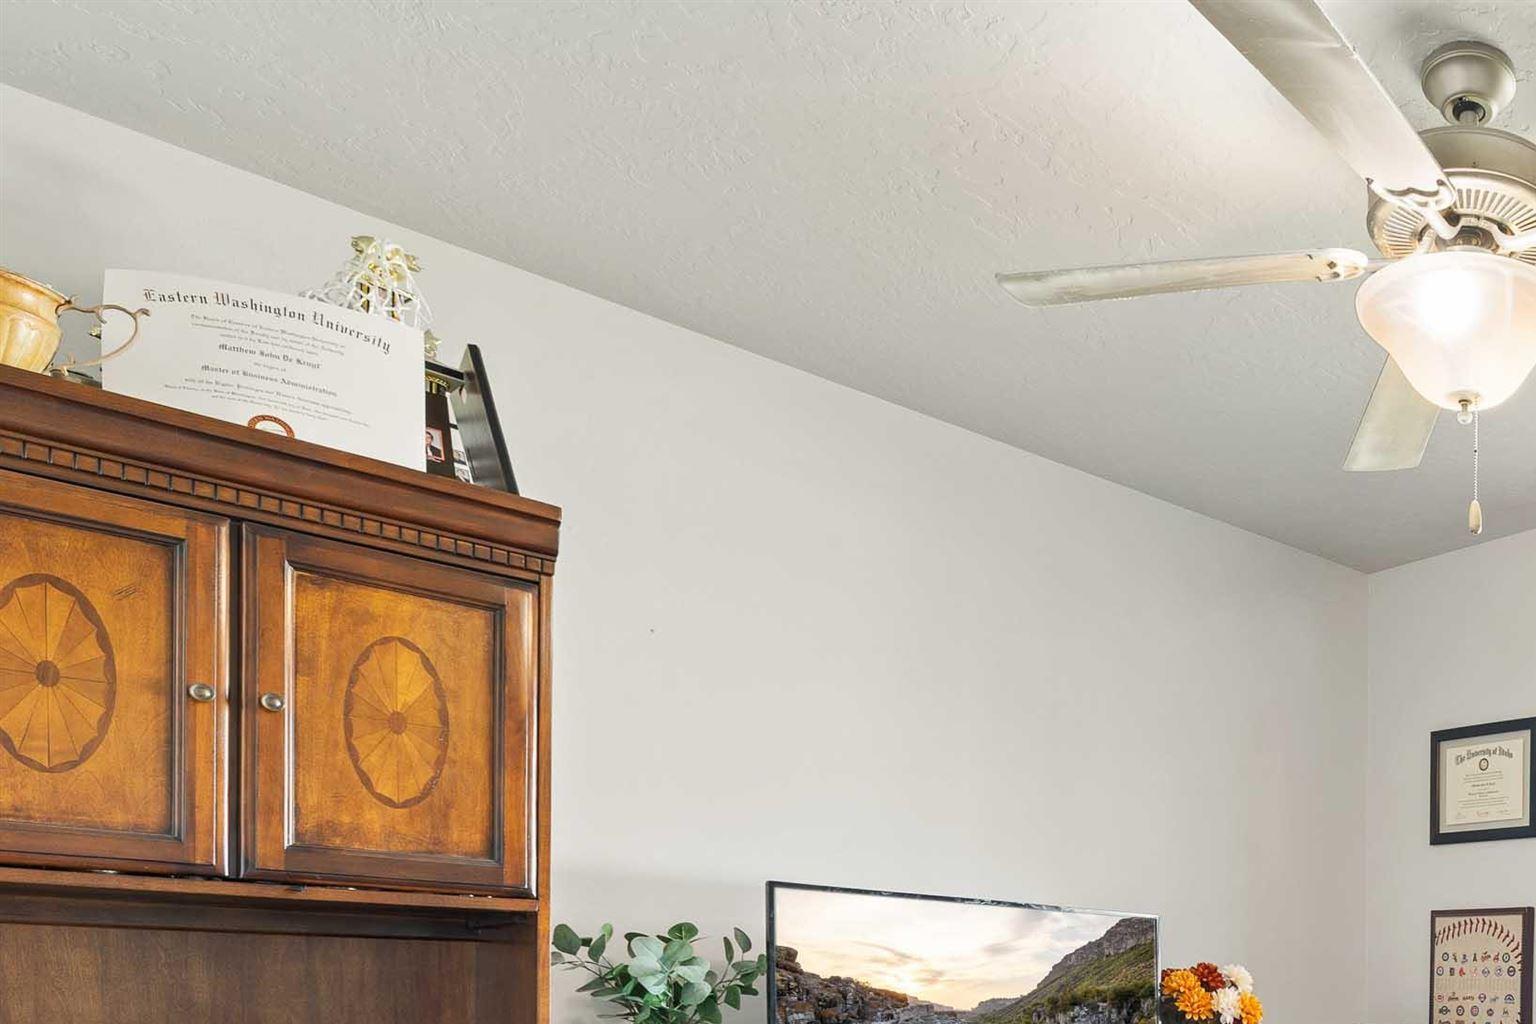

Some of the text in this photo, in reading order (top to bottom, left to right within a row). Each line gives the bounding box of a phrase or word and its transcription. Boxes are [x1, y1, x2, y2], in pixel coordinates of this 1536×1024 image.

[143, 288, 208, 304] Eastern
[214, 291, 305, 321] Washington
[312, 310, 391, 355] University
